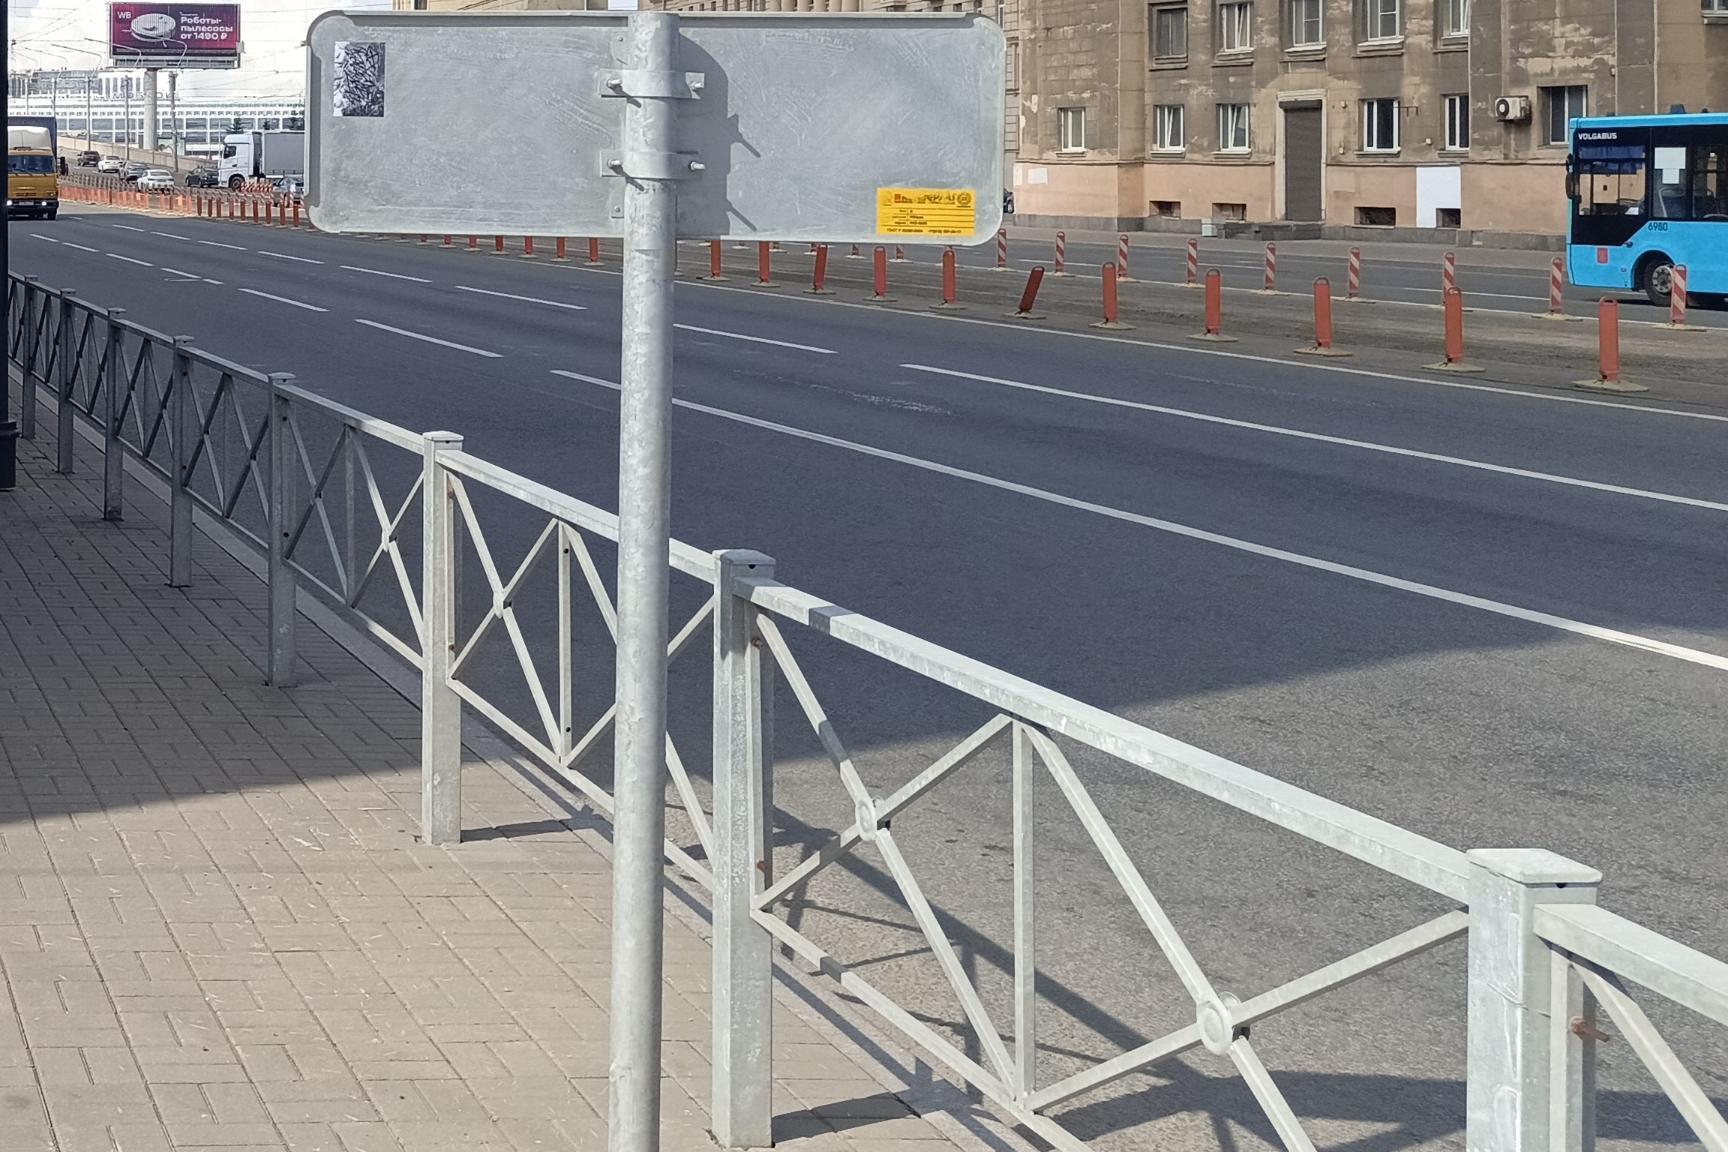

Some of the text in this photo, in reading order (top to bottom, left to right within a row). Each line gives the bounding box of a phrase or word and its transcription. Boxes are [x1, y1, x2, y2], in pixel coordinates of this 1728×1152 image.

[117, 11, 132, 19] WB
[181, 16, 222, 25] Роботы-
[1578, 132, 1617, 141] VOLGABUS
